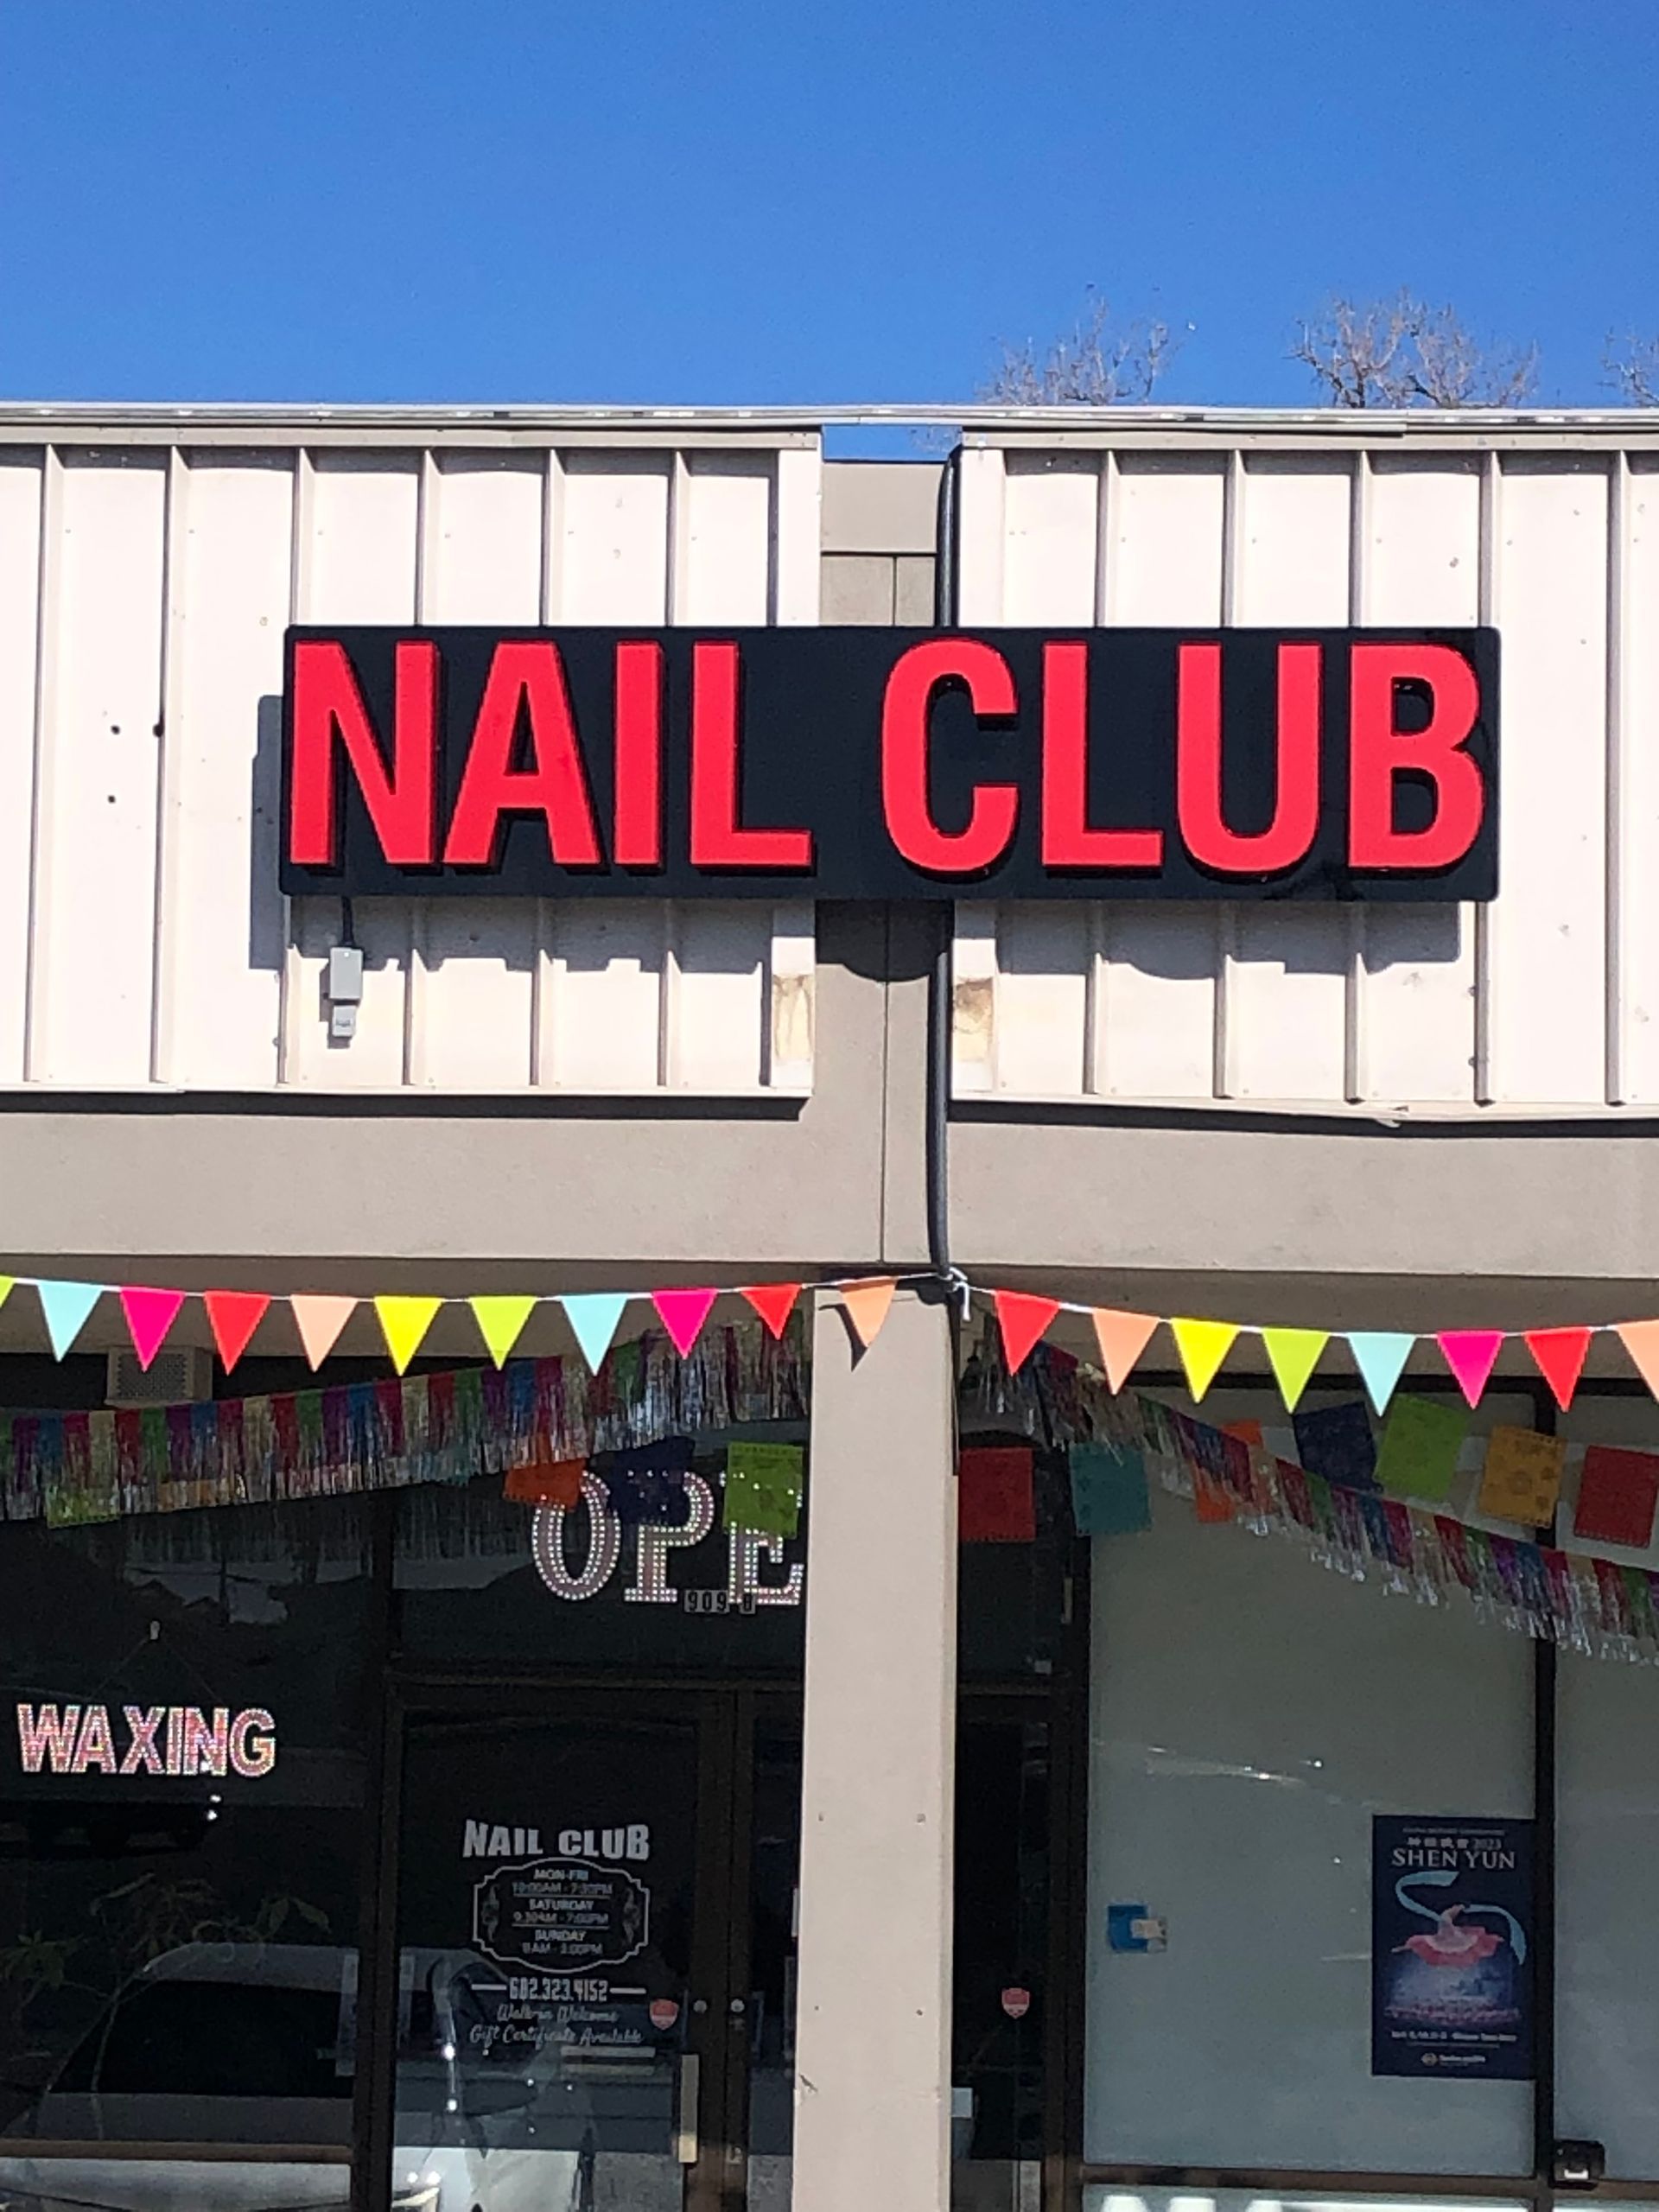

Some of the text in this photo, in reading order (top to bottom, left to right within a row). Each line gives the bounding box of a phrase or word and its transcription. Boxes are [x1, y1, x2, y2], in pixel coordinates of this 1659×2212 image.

[289, 636, 1485, 874] NAIL CLUB
[687, 1591, 727, 1612] 909
[16, 1703, 277, 1777] WAXING
[462, 1819, 650, 1860] NAIL CLUB
[1392, 1848, 1515, 1869] SHEN YUN
[529, 1898, 594, 1911] SATURDAY
[534, 1929, 588, 1942] SUNDAY
[509, 1977, 608, 2002] 602.323.4152
[470, 2023, 501, 2048] Gift
